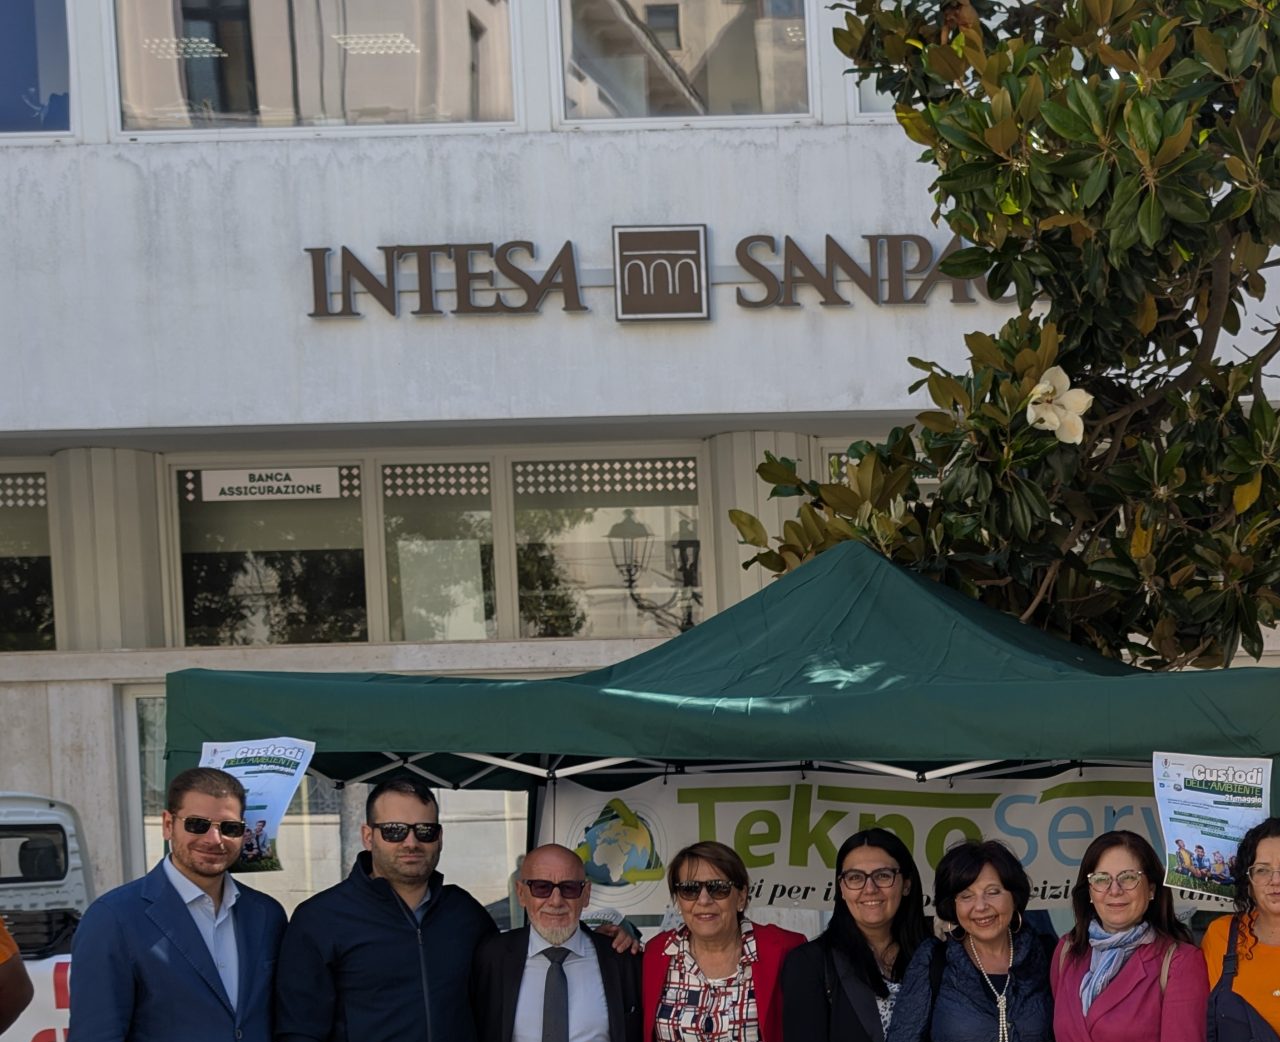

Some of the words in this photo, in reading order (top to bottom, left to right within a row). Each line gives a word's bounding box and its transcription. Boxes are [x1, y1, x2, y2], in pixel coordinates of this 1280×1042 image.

[303, 239, 589, 318] INTESA
[735, 232, 1020, 306] SANPA
[248, 472, 292, 483] BANCA
[219, 484, 322, 496] ASSICURAZIONE
[235, 744, 304, 760] Custodi
[1192, 764, 1263, 785] Custodi
[1185, 779, 1262, 796] DELL'AMBIENTE
[768, 883, 816, 905] per
